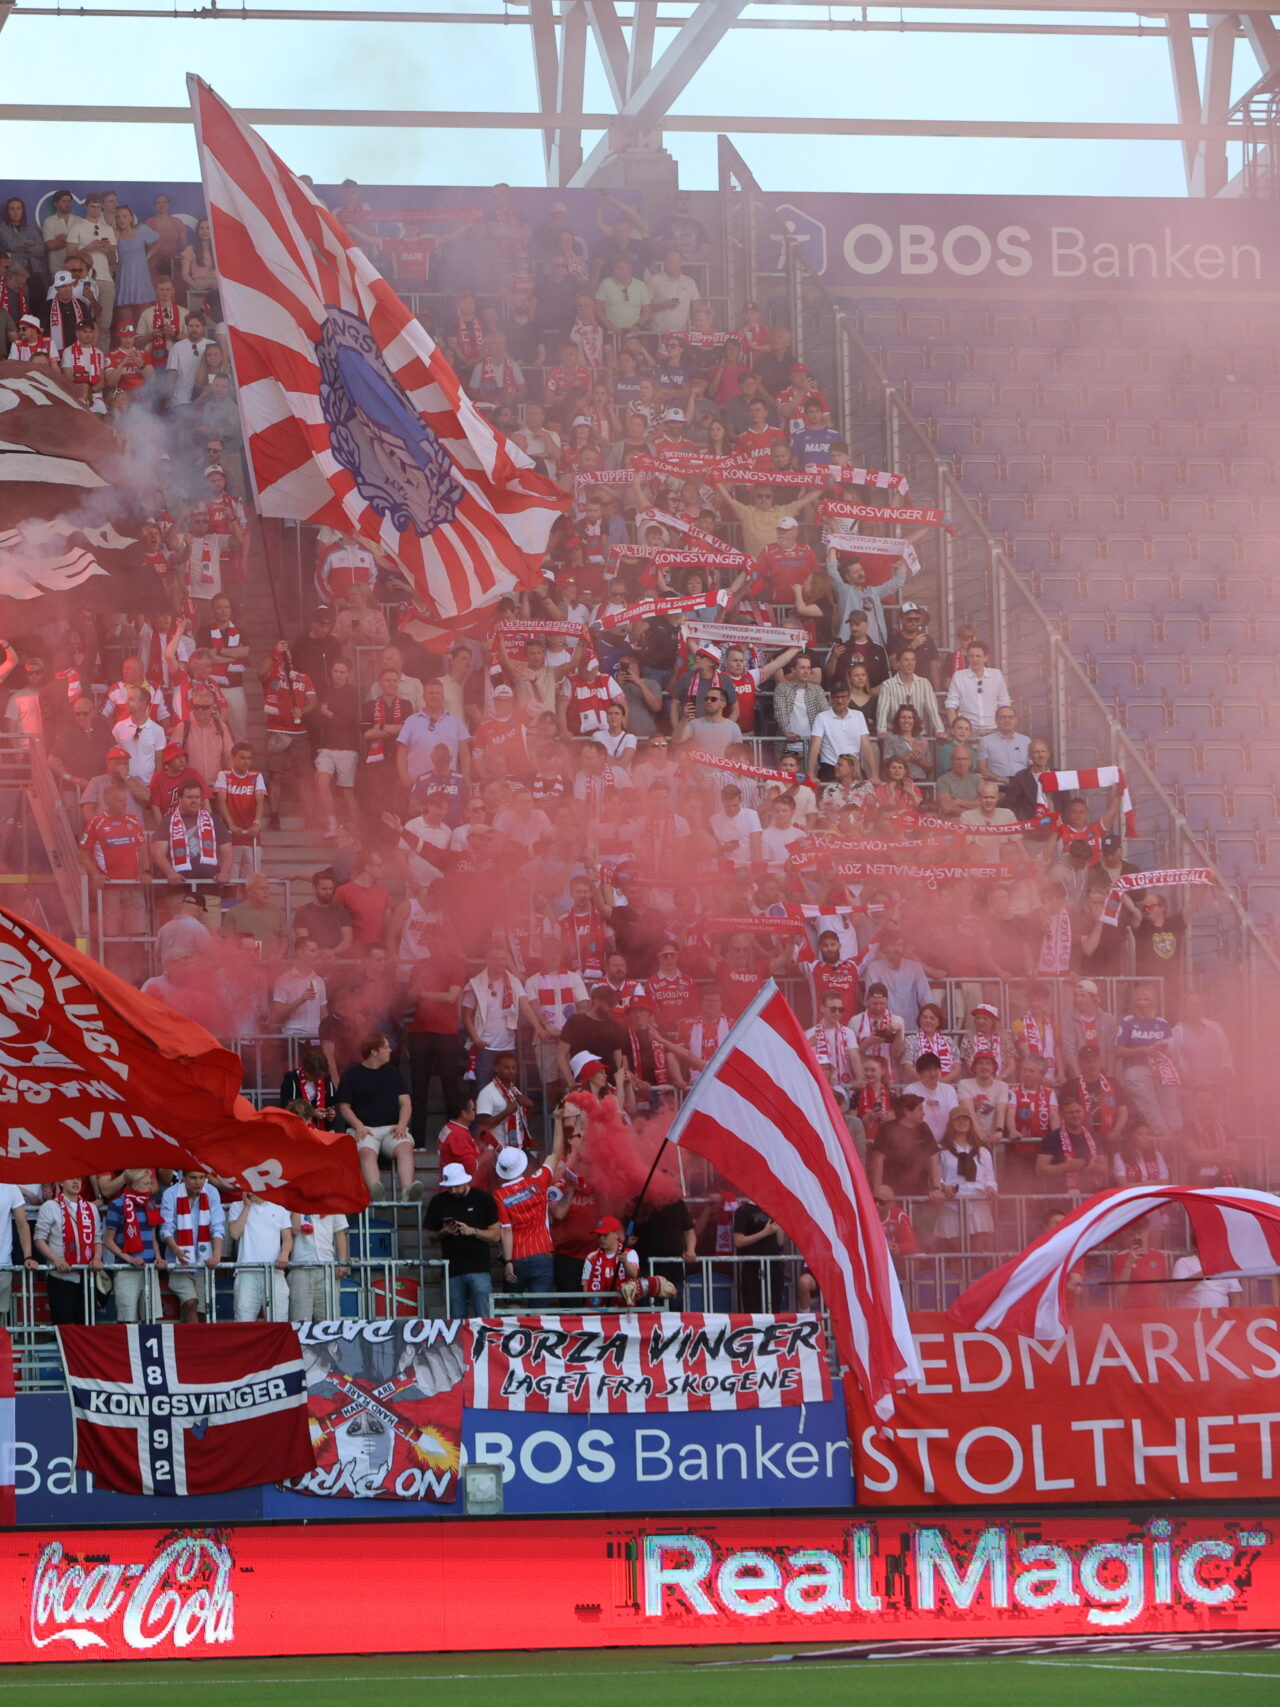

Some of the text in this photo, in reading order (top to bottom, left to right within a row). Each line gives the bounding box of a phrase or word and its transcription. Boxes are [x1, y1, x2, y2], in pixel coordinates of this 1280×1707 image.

[843, 223, 1262, 280] OBOS Banken
[722, 468, 824, 485] KONGSVINGER IL
[827, 502, 937, 521] KONGSVINGER IL
[655, 552, 744, 566] KONGSVINGER
[621, 604, 656, 620] KOMMER
[657, 601, 671, 610] FRA
[690, 750, 793, 780] KONGSVINGER IL
[227, 784, 255, 796] MAPEI
[1129, 871, 1208, 888] TOPPFOTBALL
[1131, 1029, 1165, 1040] MAPEI
[471, 1319, 822, 1368] FORZA VINGER
[913, 1317, 1280, 1395] EDMARKS
[89, 1377, 288, 1417] KONGSVINGER
[501, 1366, 800, 1400] LAGET FRA SKOGENE
[460, 1424, 856, 1485] BOS Banken
[861, 1412, 1280, 1495] STOLTHET
[644, 1524, 883, 1617] Real
